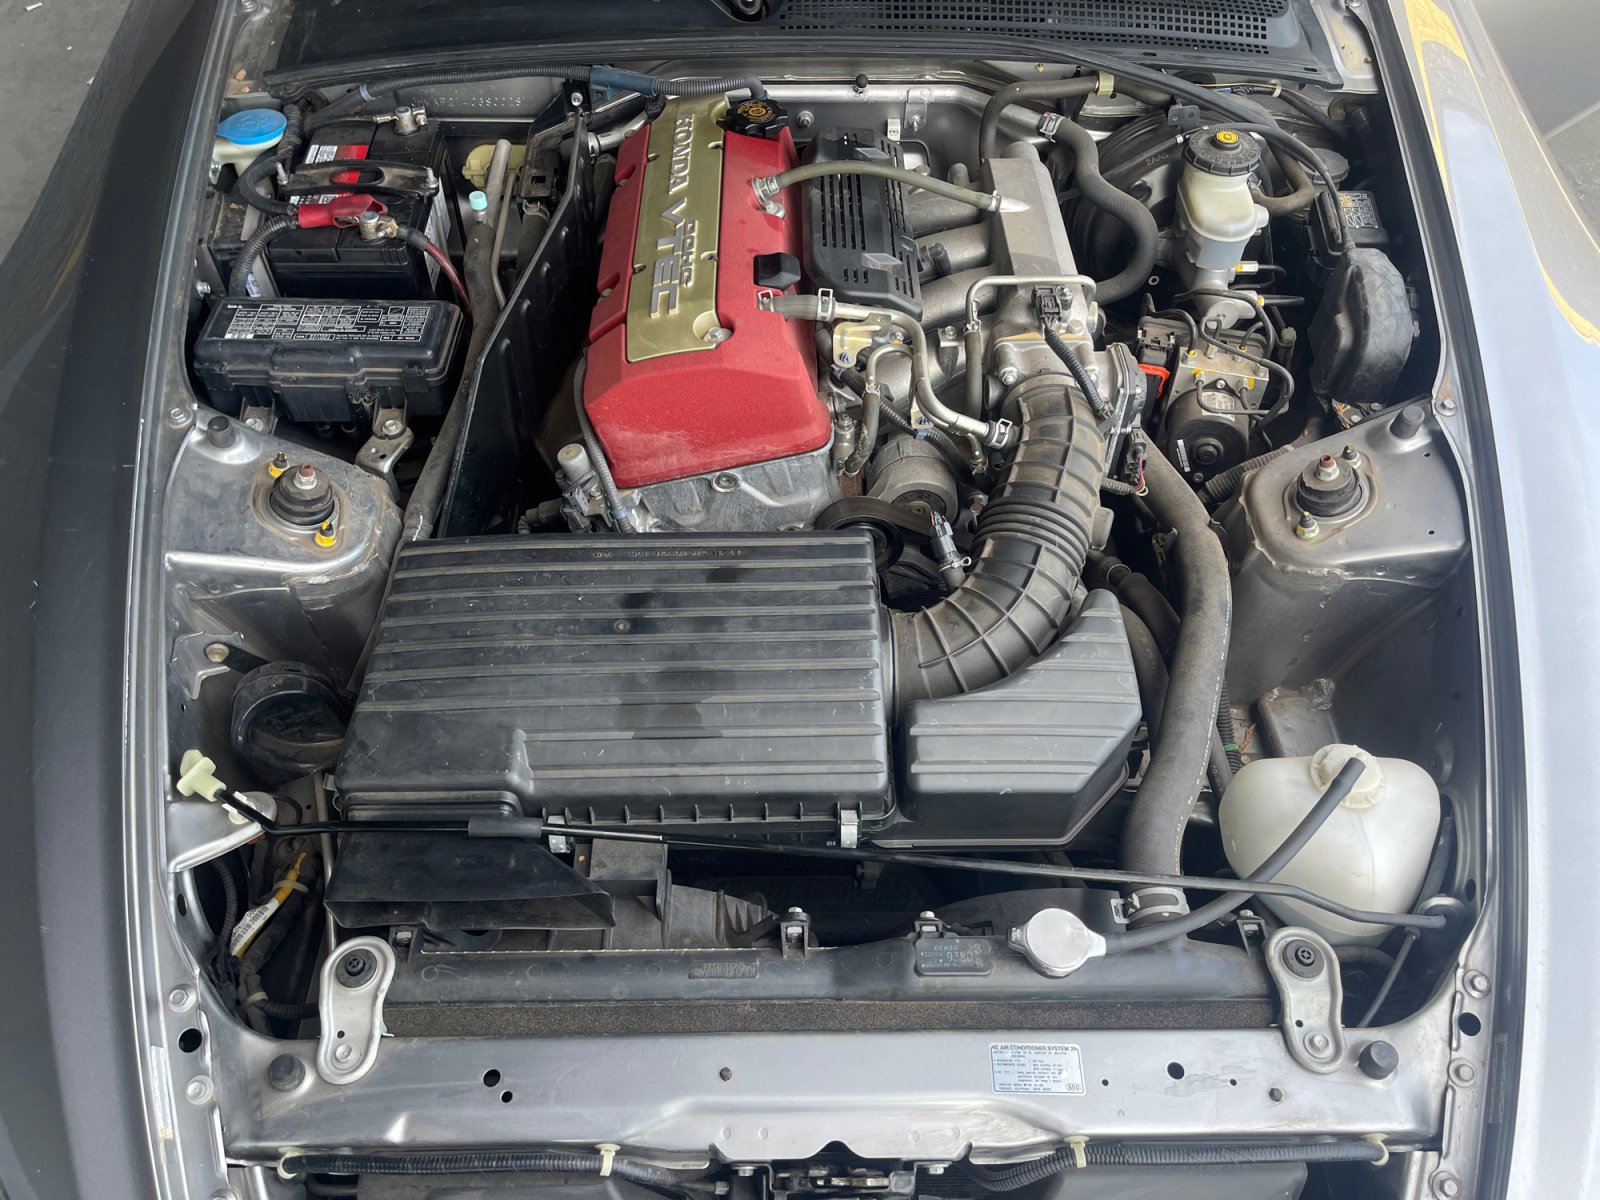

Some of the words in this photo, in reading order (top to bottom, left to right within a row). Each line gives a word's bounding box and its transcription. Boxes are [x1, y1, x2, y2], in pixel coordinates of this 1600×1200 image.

[669, 113, 695, 195] HONDA
[650, 197, 687, 319] VTEC
[680, 219, 698, 287] DOHC
